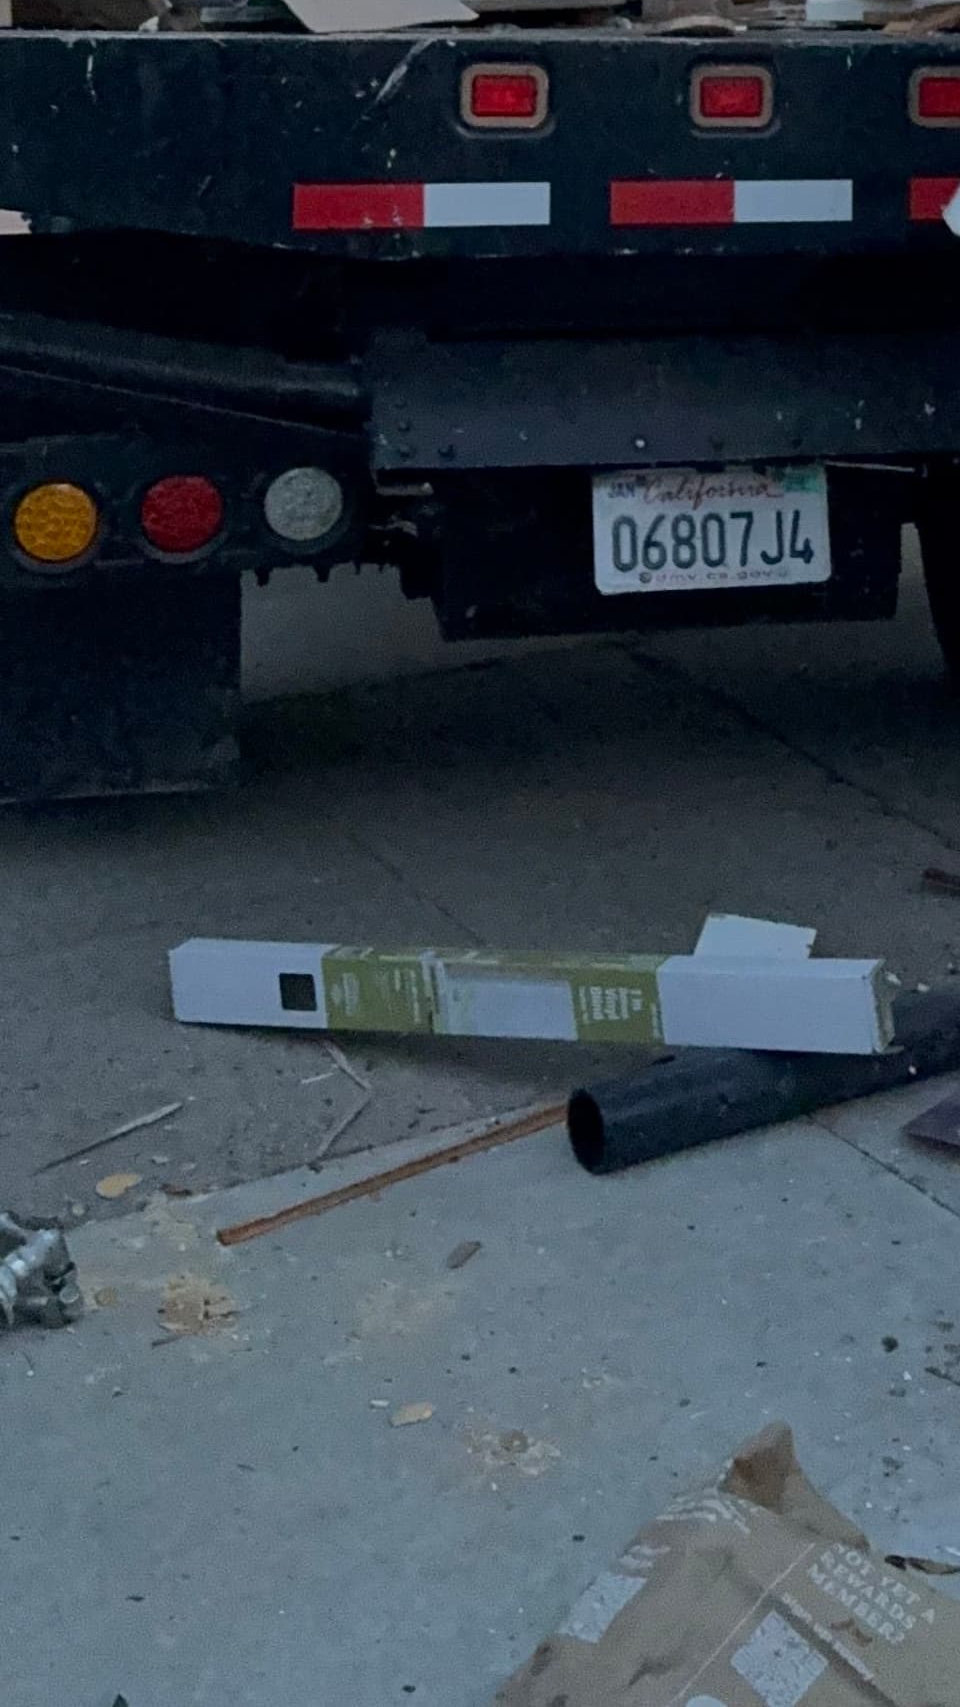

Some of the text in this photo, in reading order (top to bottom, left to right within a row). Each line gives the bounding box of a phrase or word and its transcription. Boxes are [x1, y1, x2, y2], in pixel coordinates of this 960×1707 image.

[643, 472, 784, 511] California
[612, 509, 814, 572] 06807J4
[819, 1550, 917, 1630] REWARDS
